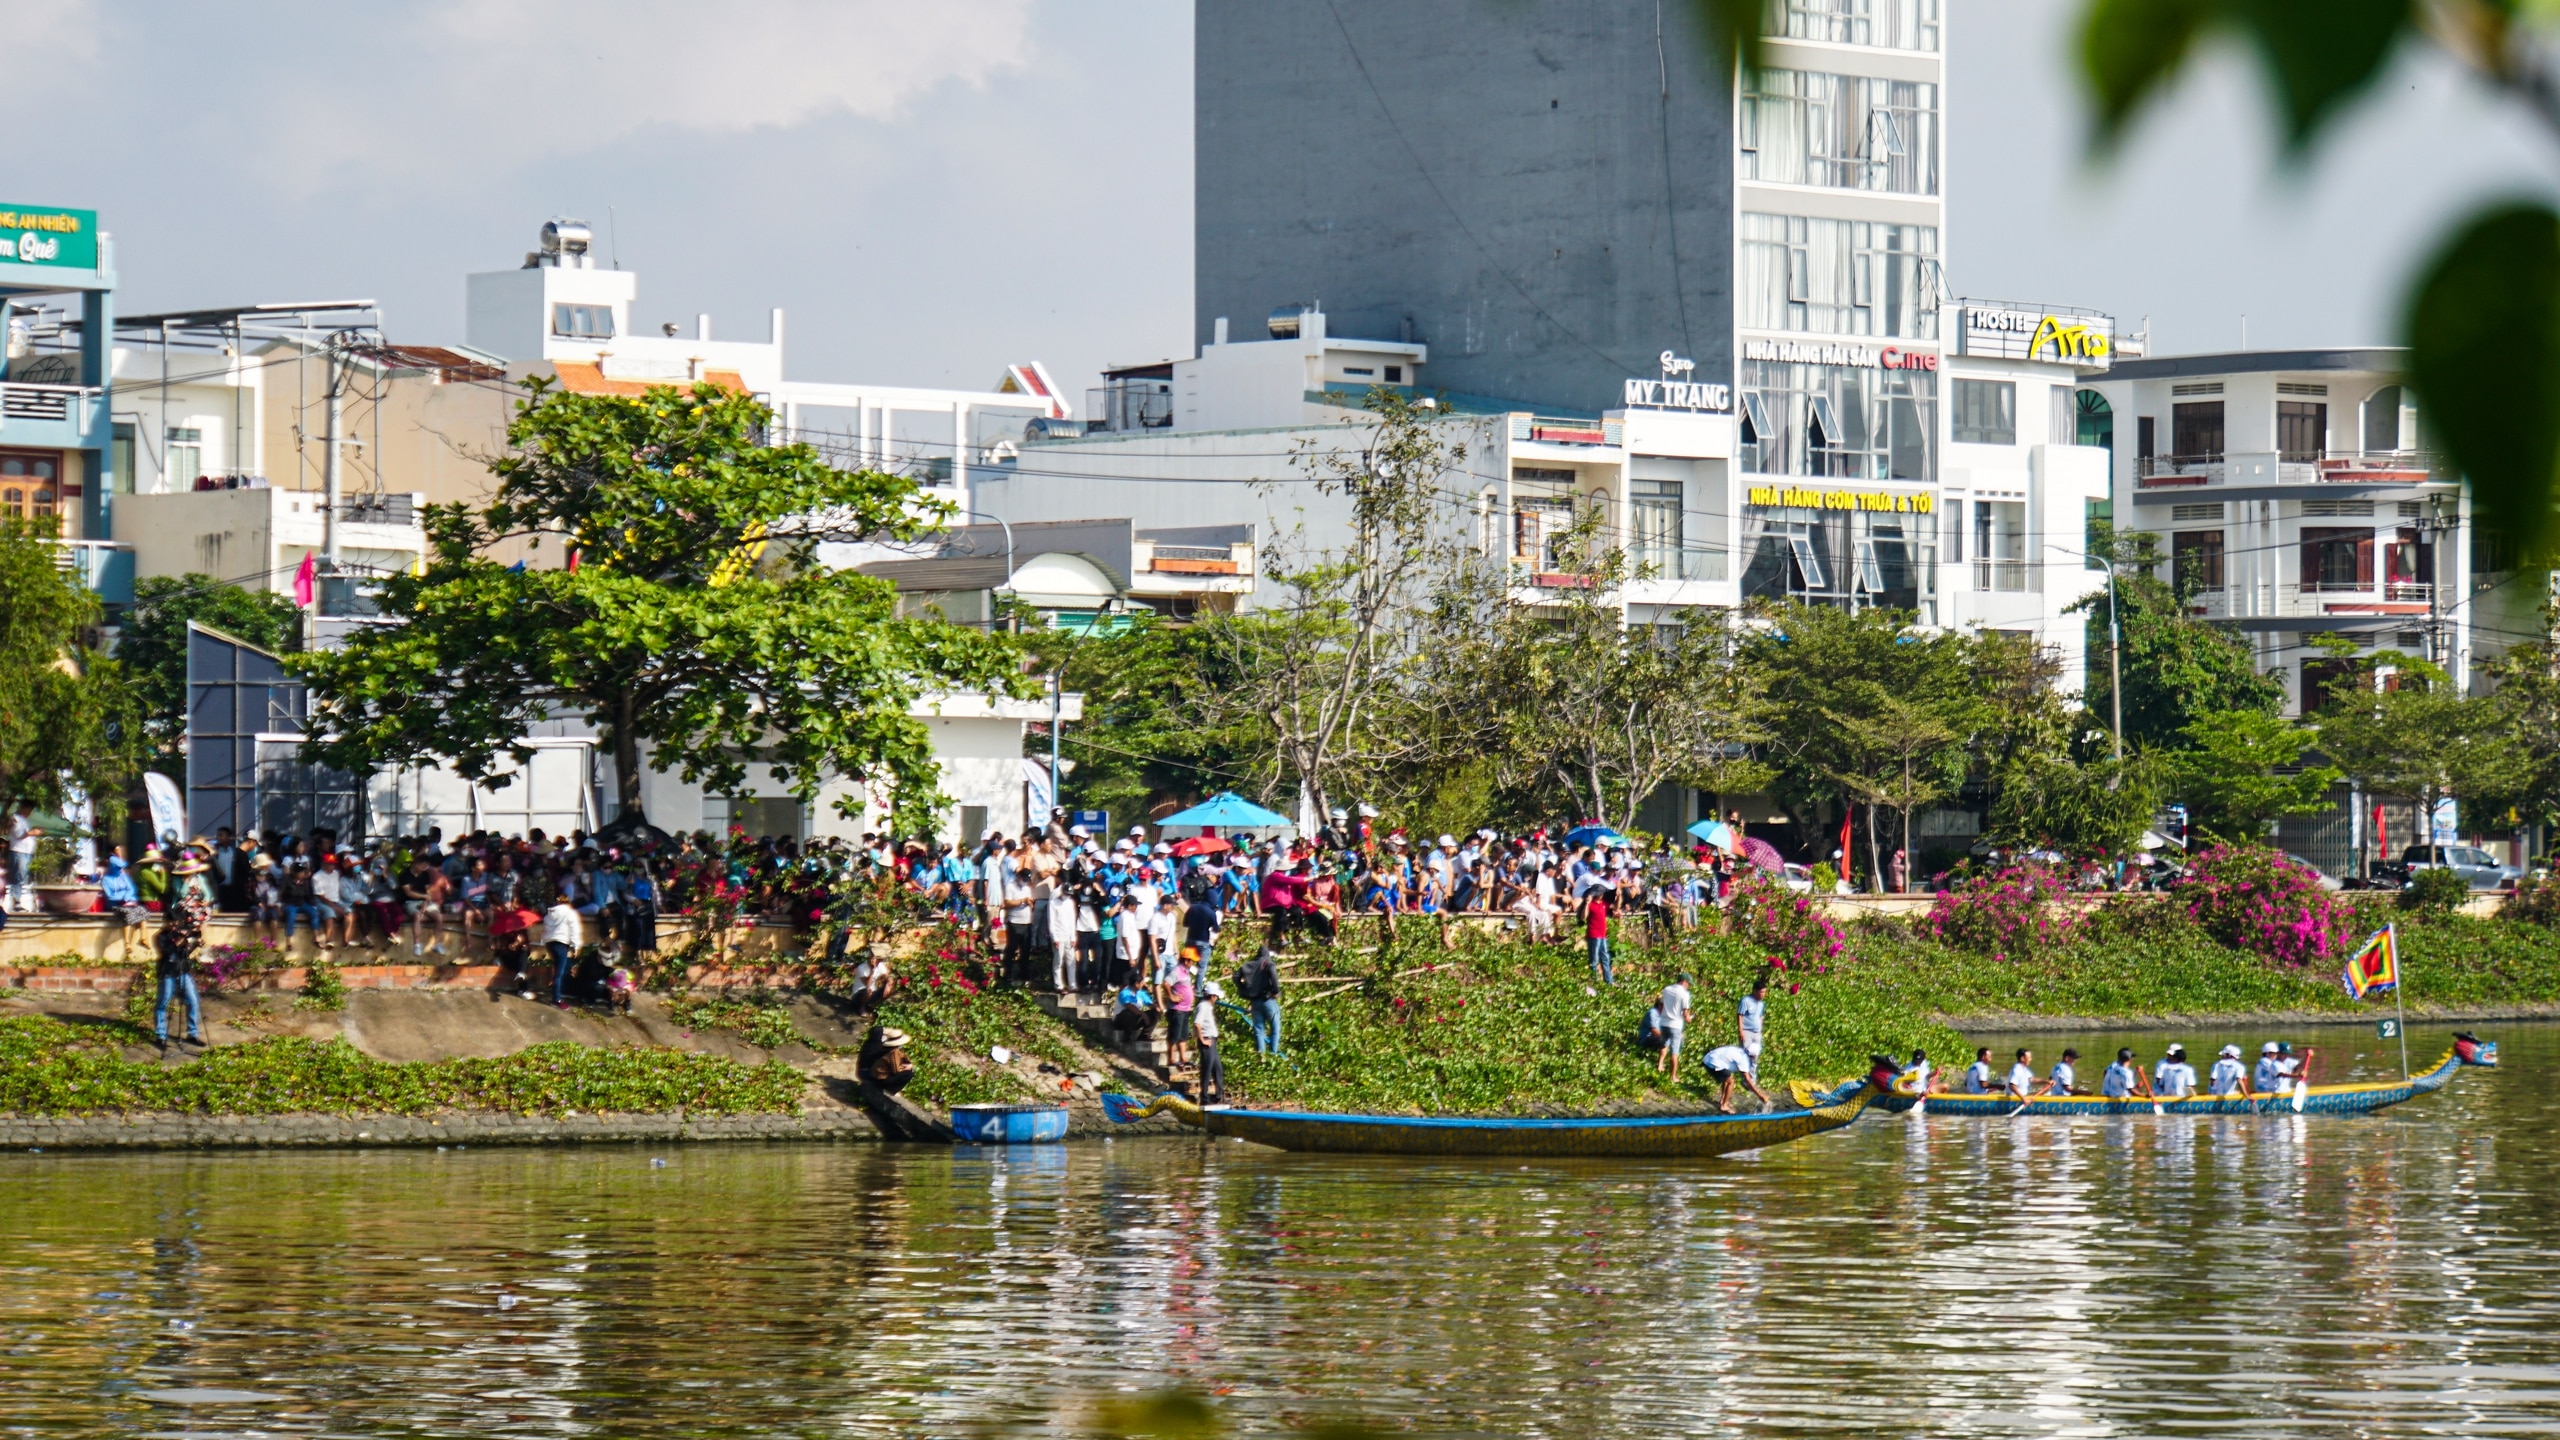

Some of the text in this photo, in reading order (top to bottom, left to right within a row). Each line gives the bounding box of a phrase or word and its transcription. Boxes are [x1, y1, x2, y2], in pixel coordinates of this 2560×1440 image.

[18, 214, 37, 230] AN
[38, 213, 80, 233] NHIÊN
[18, 231, 59, 262] Quê
[2028, 315, 2108, 359] Aria
[1660, 350, 1696, 375] Spa
[1745, 339, 1775, 361] NHÀ
[1778, 341, 1820, 364] HÀNG
[1625, 379, 1729, 411] MY TRANG
[1749, 484, 1779, 506] NHÀ
[1782, 486, 1822, 509] HÀNG
[1825, 489, 1855, 511] CƠM
[1896, 495, 1907, 513] &
[1910, 491, 1933, 514] TỐI
[2382, 1020, 2396, 1037] 2
[981, 1115, 1006, 1138] 4
